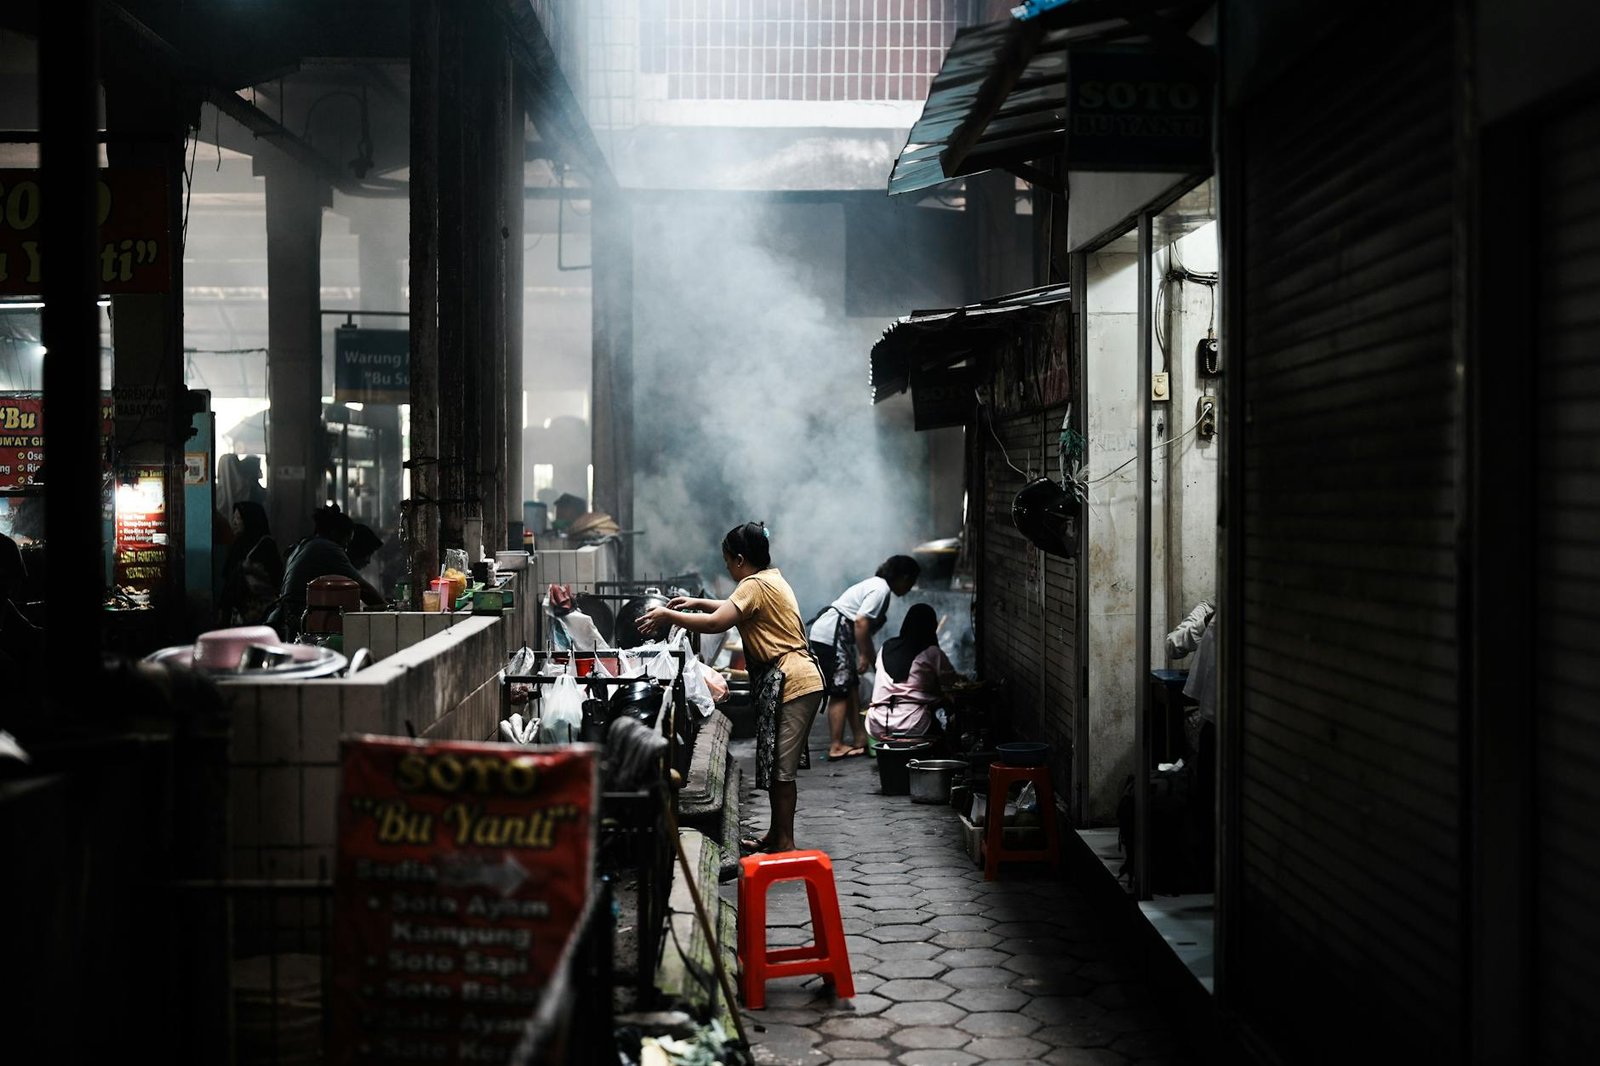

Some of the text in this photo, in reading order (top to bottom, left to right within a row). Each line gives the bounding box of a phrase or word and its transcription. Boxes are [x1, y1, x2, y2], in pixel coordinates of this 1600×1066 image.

[1079, 80, 1200, 110] SOTO
[345, 351, 401, 368] Warung
[399, 753, 538, 793] SOTO
[391, 920, 531, 950] Kampung
[387, 949, 529, 978] Soto Sapi
